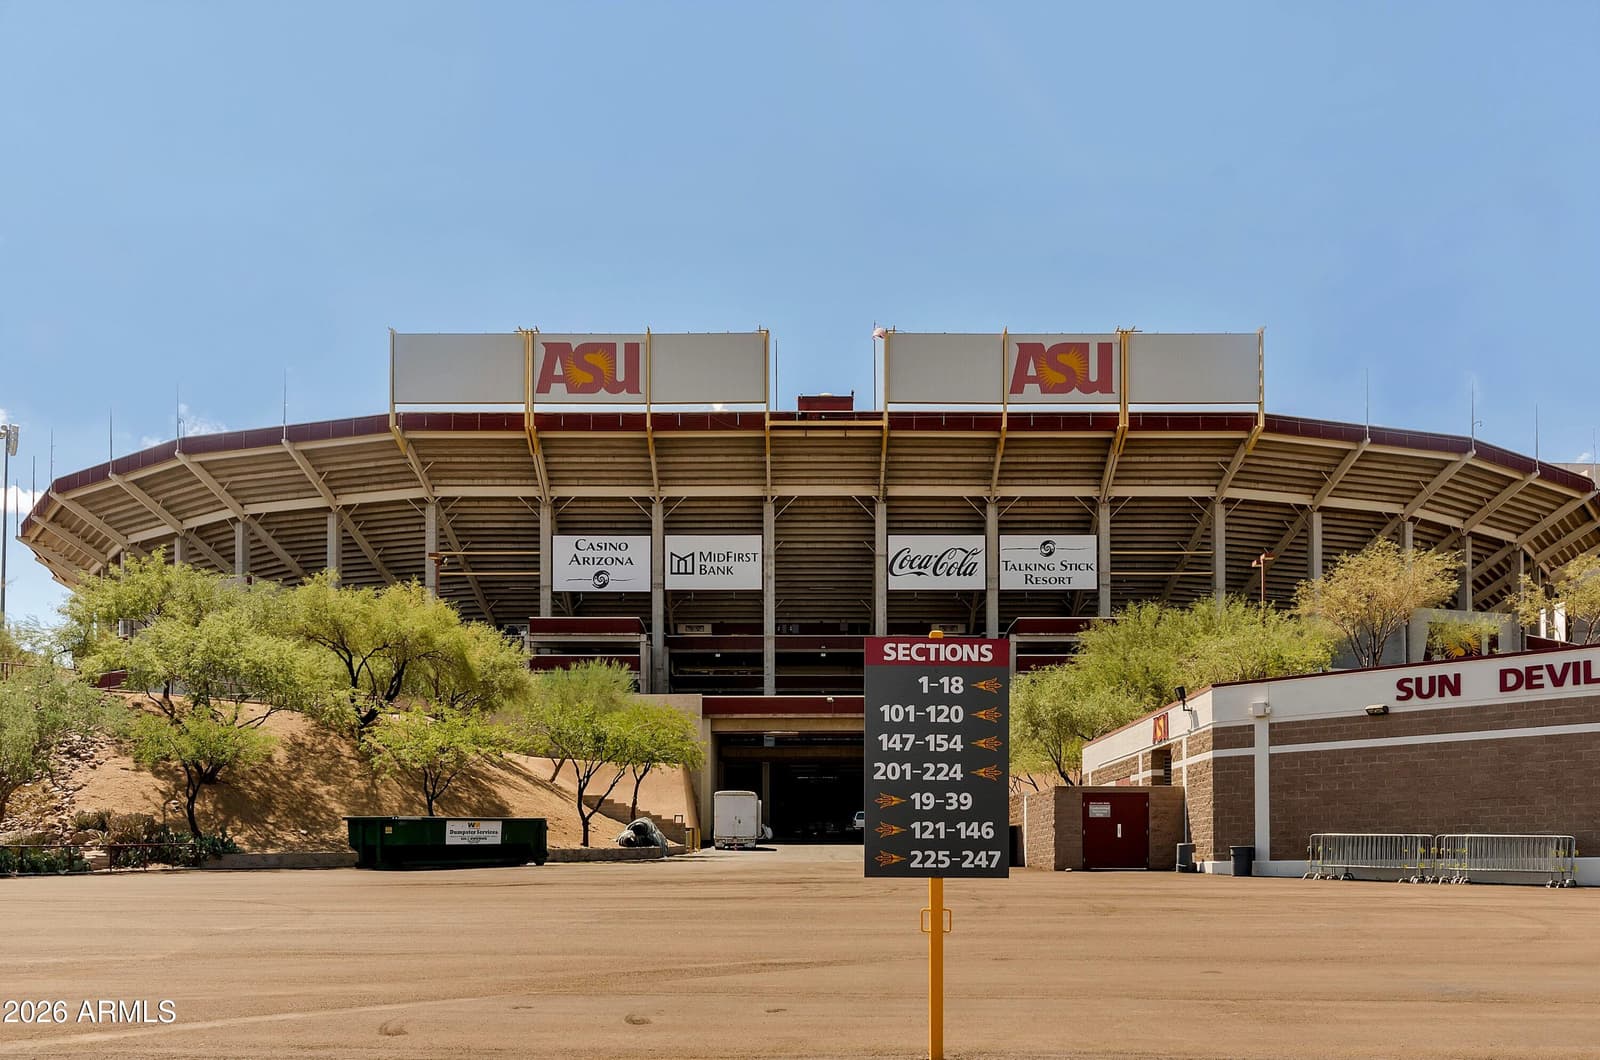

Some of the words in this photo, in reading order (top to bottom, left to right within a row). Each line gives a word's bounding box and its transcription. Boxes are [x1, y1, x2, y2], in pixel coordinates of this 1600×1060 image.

[536, 342, 642, 394] ASU
[1009, 342, 1115, 394] ASU
[883, 643, 993, 662] SECTIONS
[918, 676, 964, 694] 1-18
[1396, 673, 1461, 701] SUN
[880, 704, 964, 723] 101-120
[878, 734, 963, 752] 147-154
[873, 762, 963, 781] 201-224
[910, 792, 973, 810] 19-39
[910, 821, 994, 839] 121-146
[910, 850, 1001, 868] 225-247
